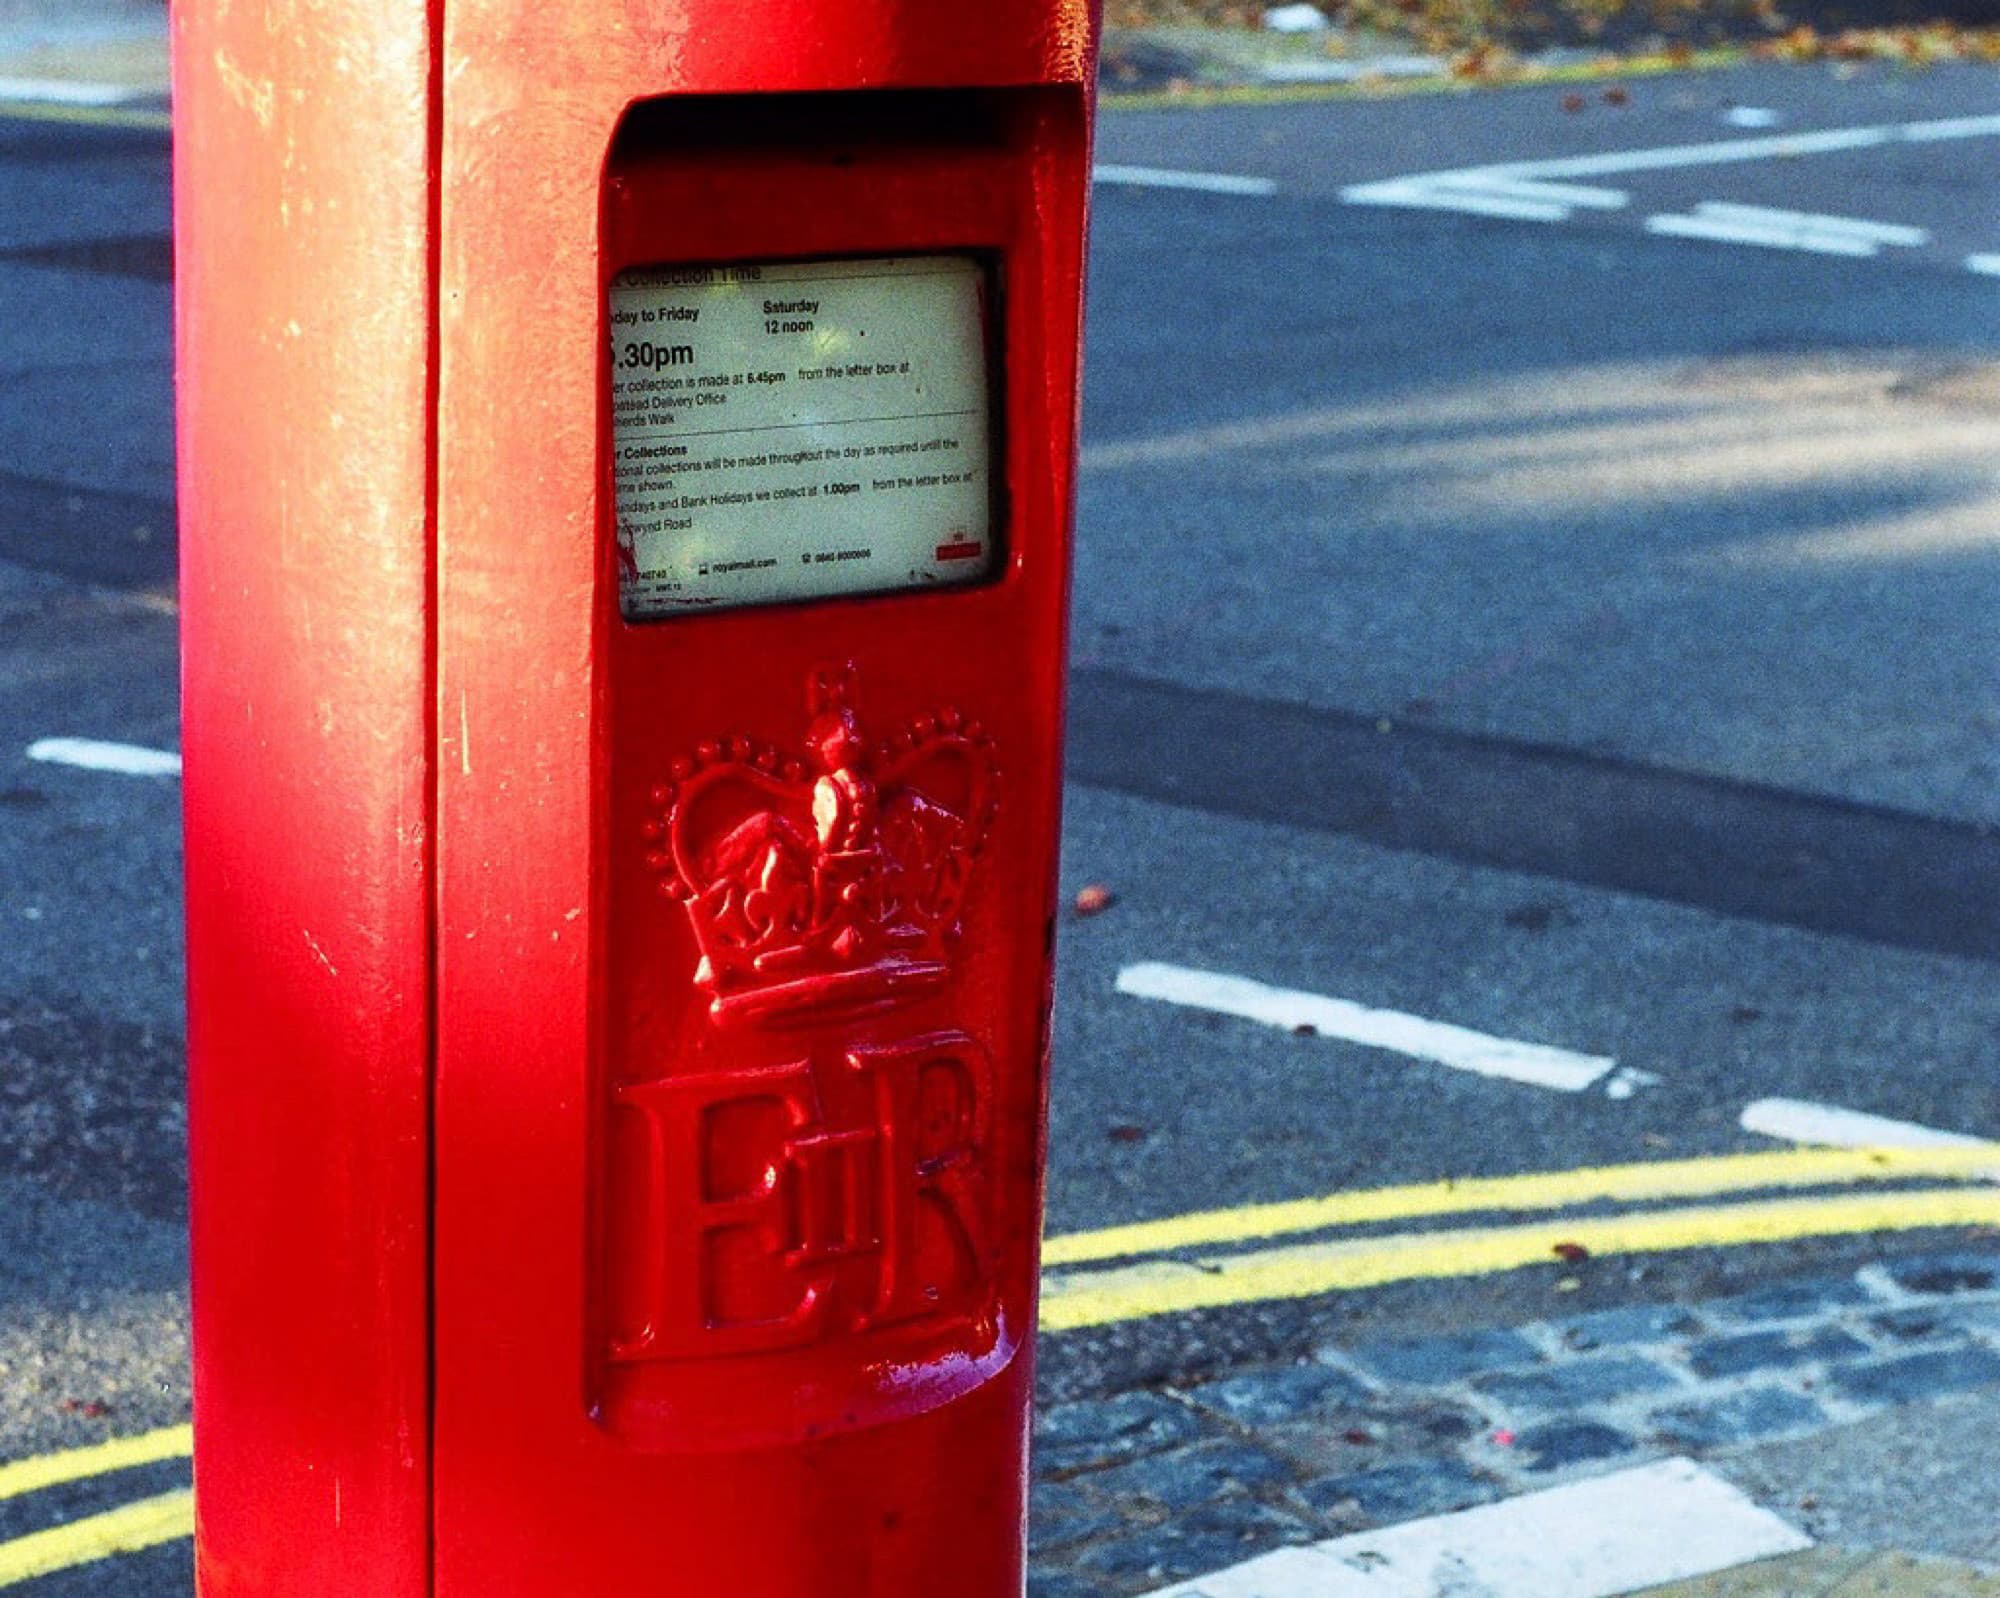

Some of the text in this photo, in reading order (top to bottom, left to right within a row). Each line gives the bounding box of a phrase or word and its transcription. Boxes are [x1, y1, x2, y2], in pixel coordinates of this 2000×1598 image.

[641, 309, 655, 322] to
[659, 306, 699, 323] Friday
[763, 299, 818, 315] Saturday
[765, 319, 814, 335] 12 noon
[628, 377, 682, 393] collection
[686, 377, 696, 388] is
[699, 373, 729, 388] made
[732, 373, 744, 385] at
[747, 370, 786, 386] 6.45pm
[799, 368, 823, 380] from
[826, 365, 843, 378] the
[845, 364, 874, 377] letter
[876, 361, 896, 375] box
[900, 361, 909, 374] at
[652, 395, 694, 410] Delivery
[695, 393, 727, 407] Office
[624, 445, 689, 460] Collections
[647, 459, 702, 475] collections
[704, 456, 721, 470] will
[723, 456, 736, 469] be
[738, 453, 766, 468] made
[769, 449, 823, 466] throughout
[826, 449, 840, 460] the
[844, 446, 860, 459] day
[864, 446, 875, 456] as
[878, 441, 919, 455] required
[920, 439, 941, 452] until
[942, 439, 959, 449] the
[658, 496, 678, 510] and
[681, 495, 707, 509] Bank
[711, 491, 752, 506] Holidays
[756, 491, 770, 501] we
[773, 486, 806, 500] collect
[807, 486, 817, 497] at
[823, 483, 860, 496] 1.00pm
[872, 479, 895, 490] from
[897, 477, 912, 488] the
[915, 474, 940, 486] letter
[942, 473, 960, 485] box
[664, 517, 692, 531] Road
